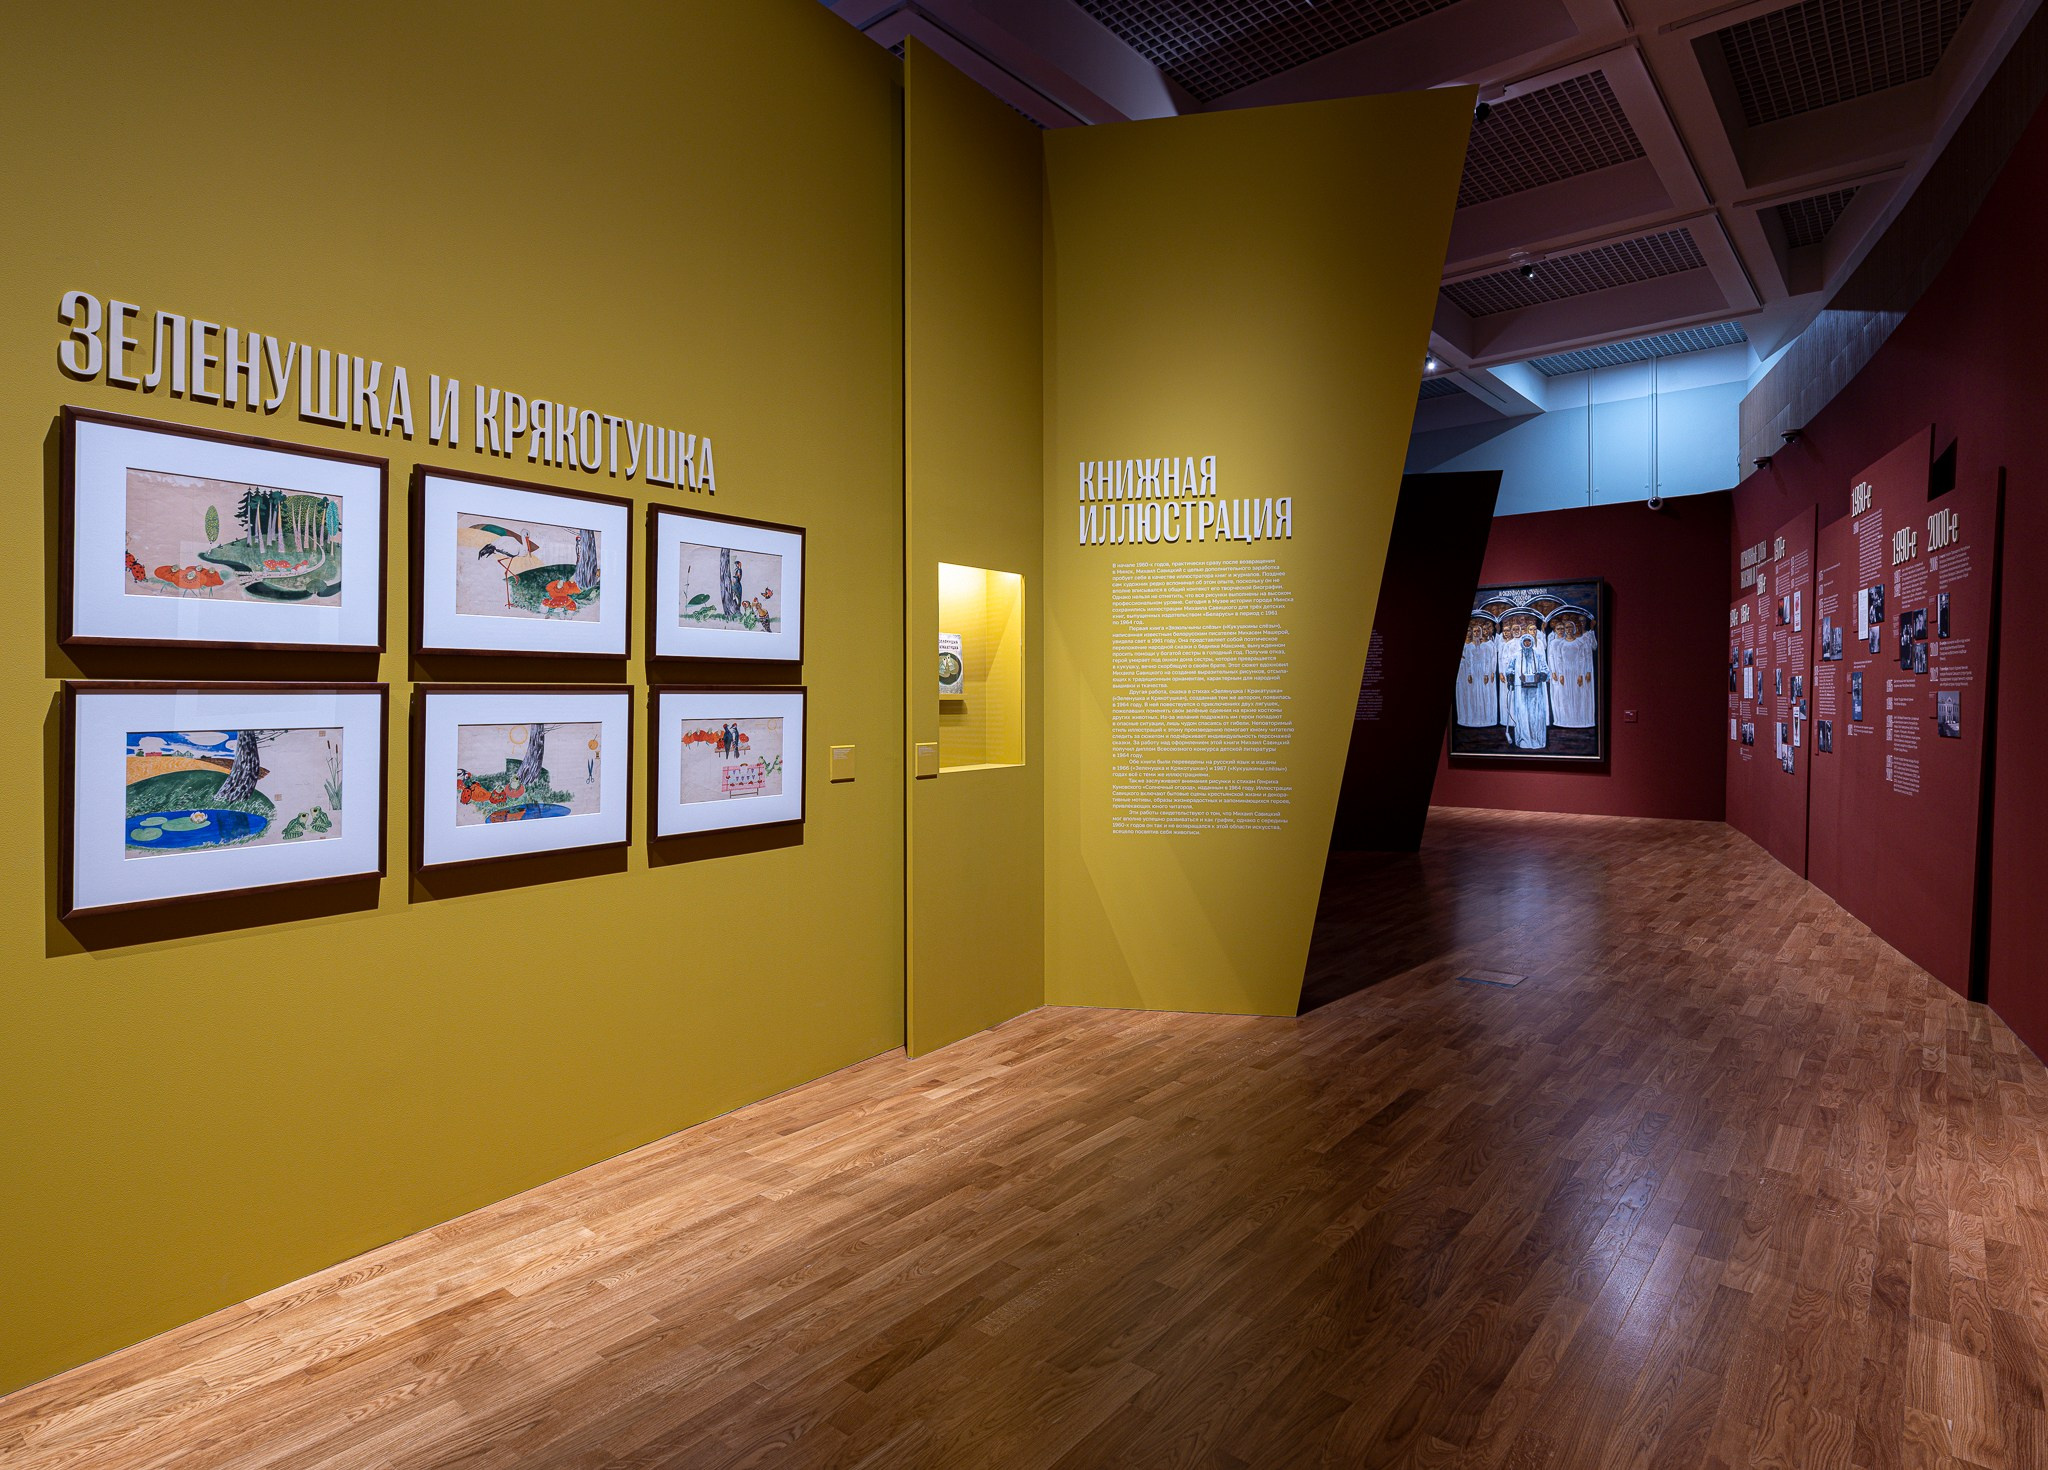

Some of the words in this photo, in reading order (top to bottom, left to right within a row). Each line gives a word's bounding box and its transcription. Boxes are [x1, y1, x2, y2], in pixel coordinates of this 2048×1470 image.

[59, 290, 414, 436] ЗЕЛЕНУШКА
[429, 374, 460, 445] И
[474, 384, 716, 492] КРЯКОТУШКА
[1079, 455, 1217, 501] КНИЖНАЯ
[1079, 496, 1292, 545] ИЛЛЮСТРАЦИЯ
[1927, 508, 1959, 552] 2000-е
[1892, 526, 1918, 566] 1990-е
